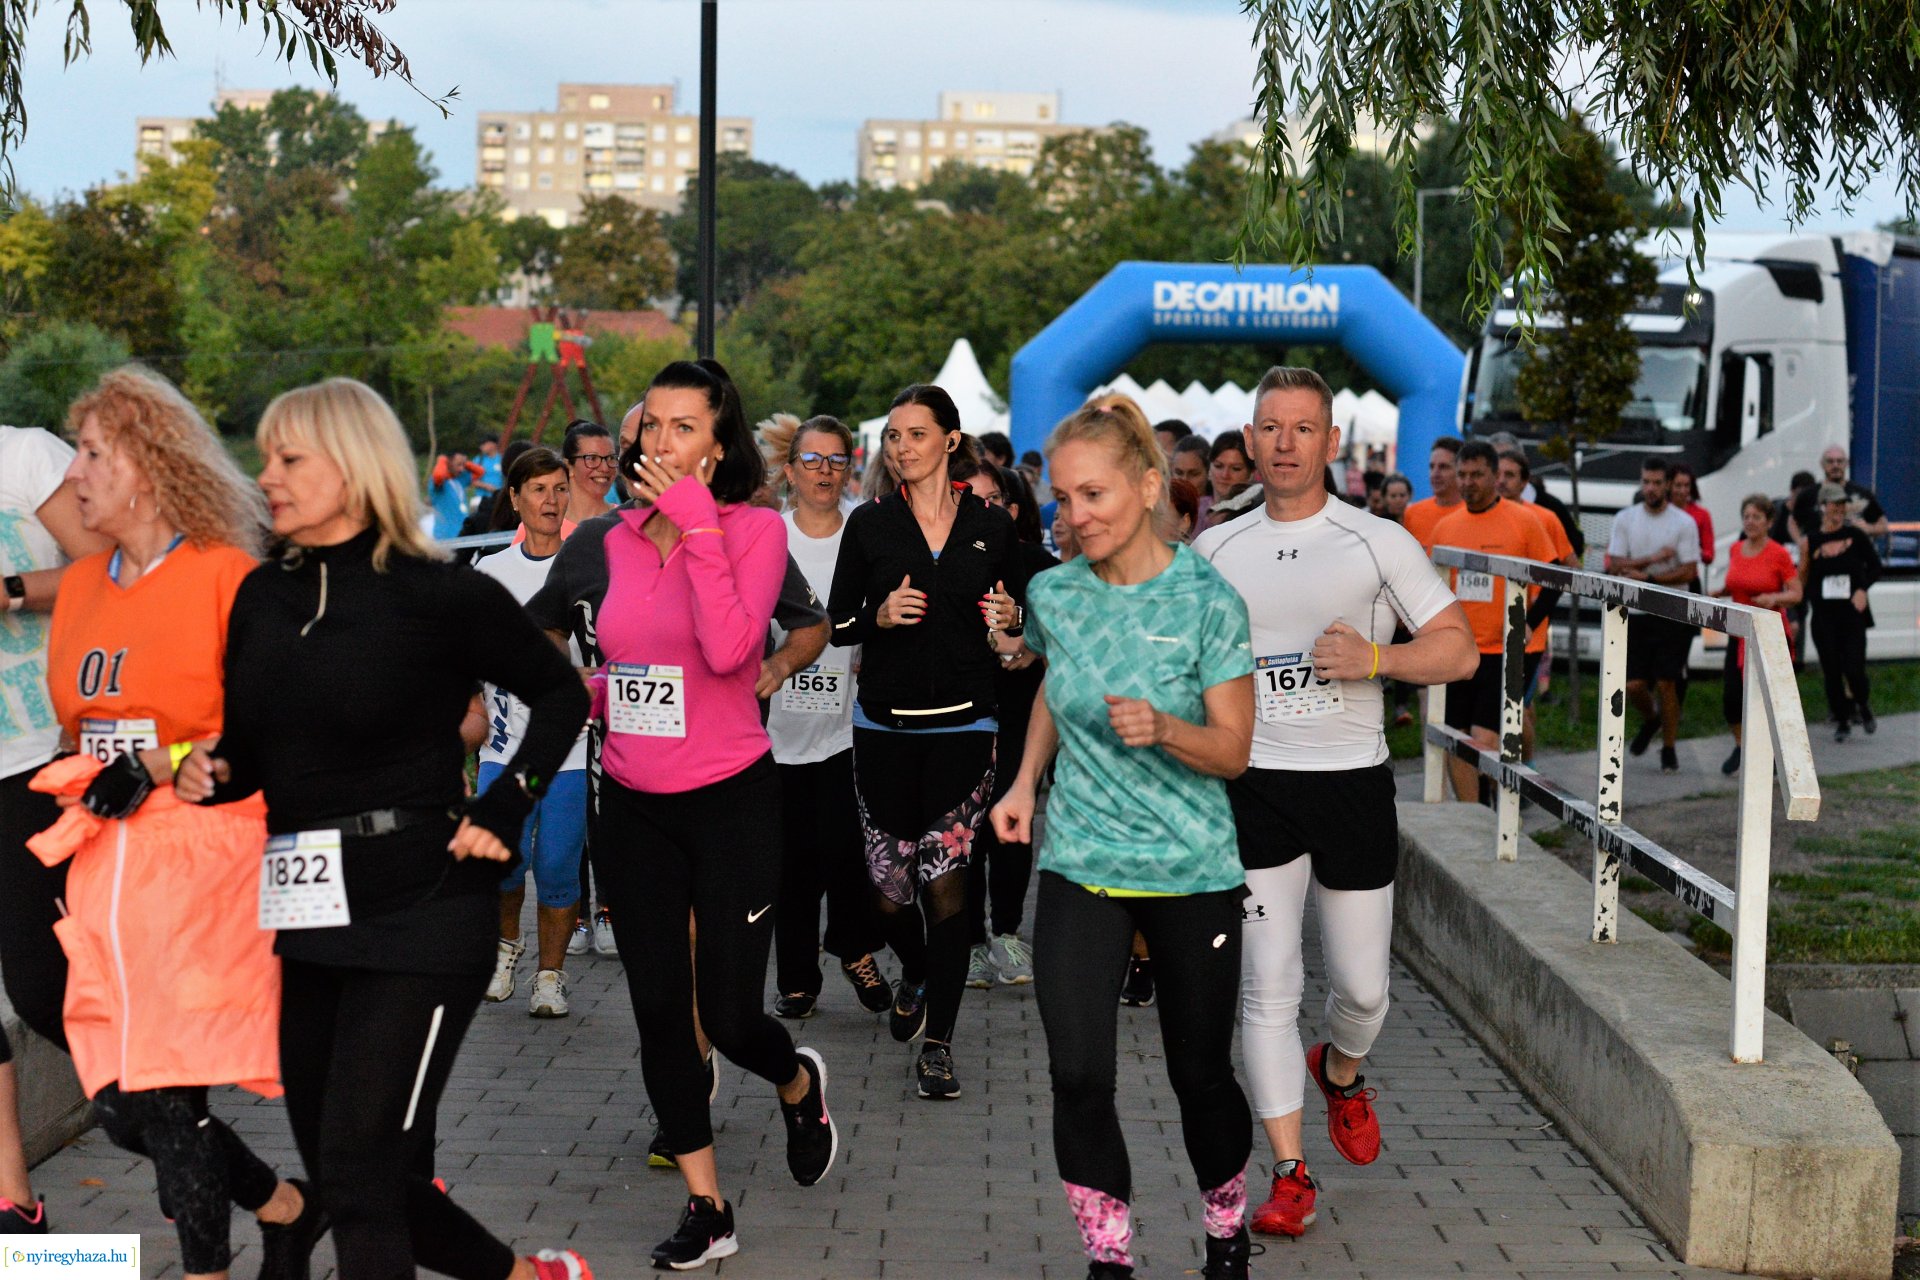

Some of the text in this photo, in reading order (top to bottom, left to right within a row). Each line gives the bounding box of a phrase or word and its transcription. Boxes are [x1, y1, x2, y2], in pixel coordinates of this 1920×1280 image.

[1153, 281, 1340, 312] DECATHLON
[78, 648, 128, 700] 01
[791, 675, 838, 692] 1563
[615, 679, 675, 705] 1672
[268, 854, 330, 887] 1822
